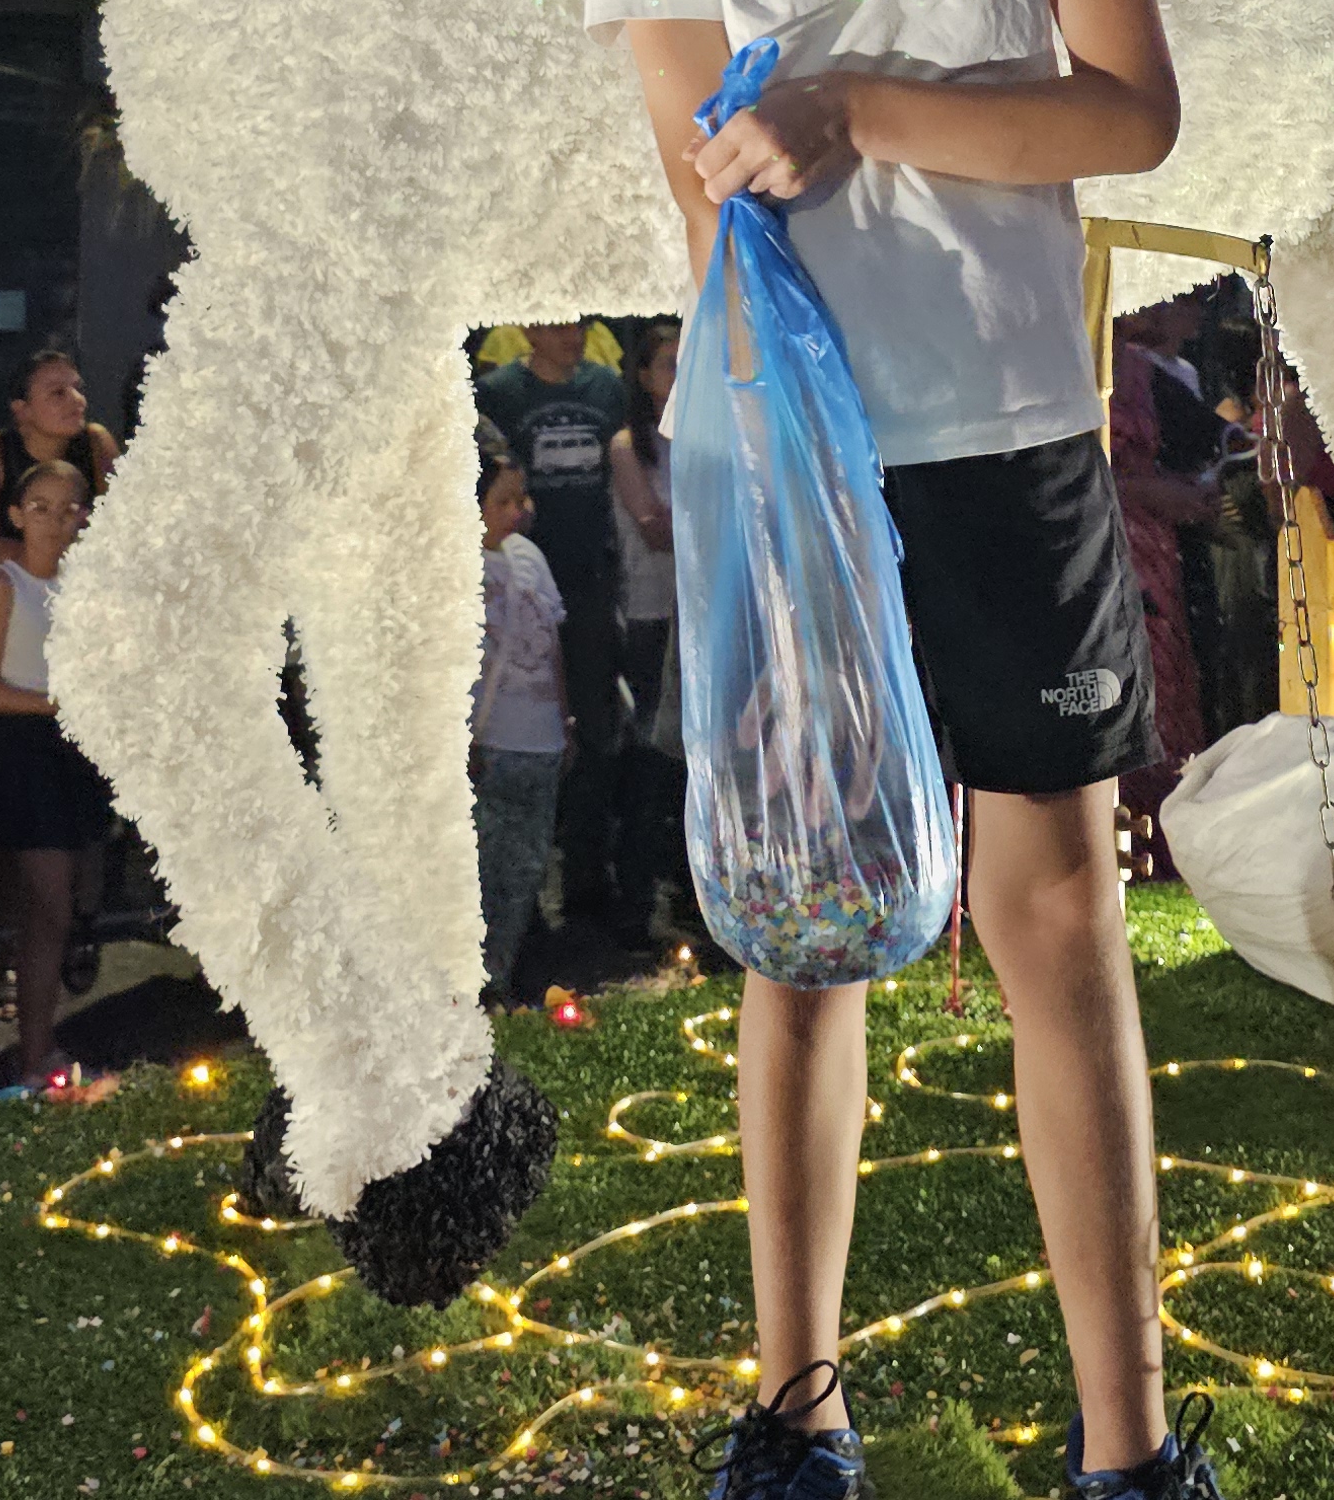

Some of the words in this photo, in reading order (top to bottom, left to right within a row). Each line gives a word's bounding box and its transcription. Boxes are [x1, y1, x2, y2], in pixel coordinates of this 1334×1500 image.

[1065, 671, 1097, 687] THE
[1041, 680, 1098, 704] NORTH
[1059, 698, 1099, 717] FACE
